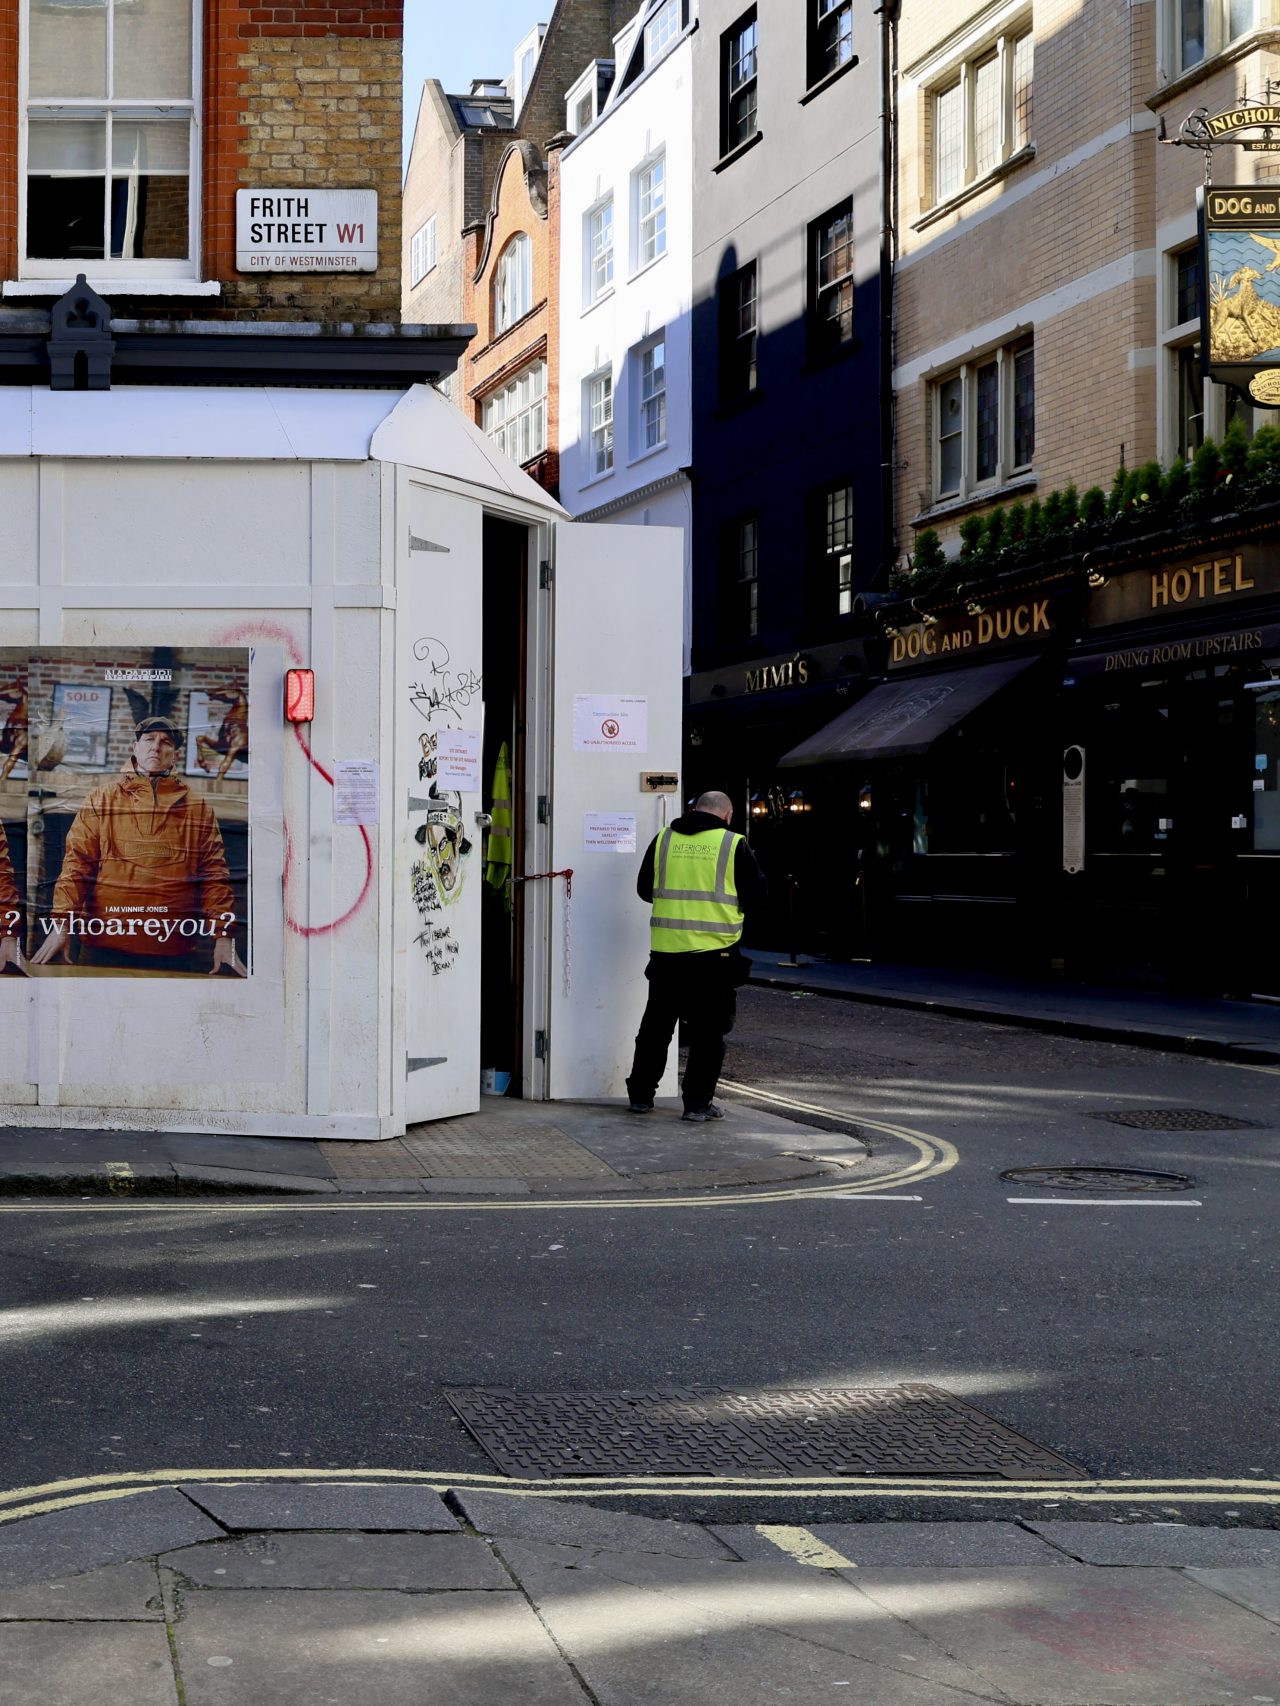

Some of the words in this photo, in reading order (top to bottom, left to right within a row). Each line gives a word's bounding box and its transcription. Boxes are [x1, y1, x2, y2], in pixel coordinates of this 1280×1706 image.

[250, 198, 309, 218] FRITH
[1214, 197, 1252, 215] DOG
[1254, 203, 1276, 214] AND
[250, 223, 327, 244] STREET
[336, 223, 364, 244] W1
[250, 256, 270, 266] CITY
[275, 256, 286, 266] OF
[289, 256, 357, 266] WESTMINSTER
[1150, 554, 1255, 609] HOTEL
[892, 628, 937, 662] DOG
[942, 629, 972, 652] AND
[978, 599, 1051, 644] DUCK
[1105, 648, 1149, 672] DINING
[1152, 643, 1192, 664] ROOM
[1195, 631, 1263, 657] UPSTAIRS
[744, 652, 808, 692] MIMI'S
[66, 692, 99, 702] SOLD
[673, 844, 711, 852] INTERIORS
[39, 911, 236, 943] whoareyou?
